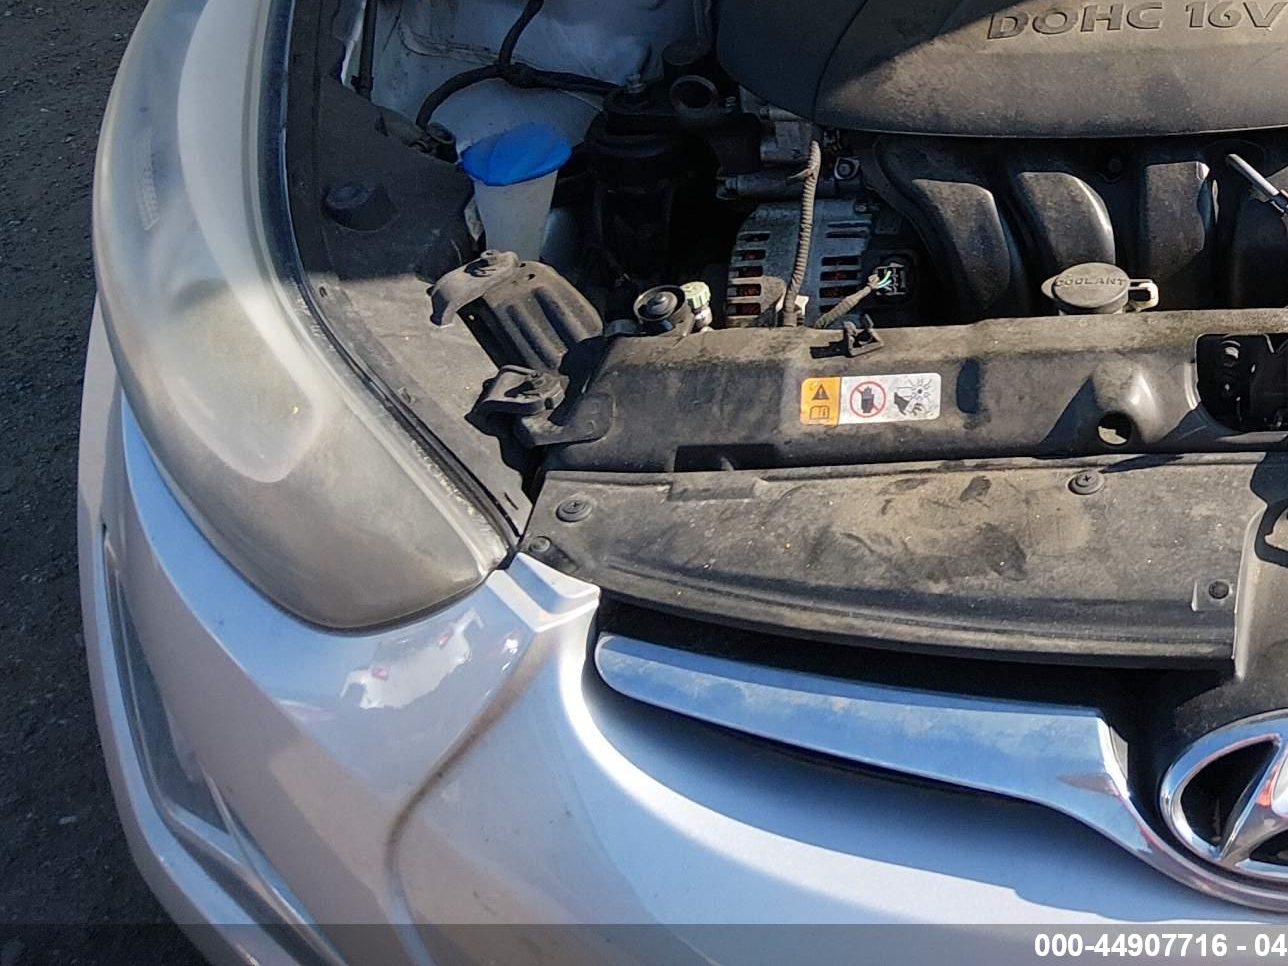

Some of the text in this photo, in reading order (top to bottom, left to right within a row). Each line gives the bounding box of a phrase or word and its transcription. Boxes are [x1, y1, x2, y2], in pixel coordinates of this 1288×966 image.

[986, 0, 1288, 40] DOHC 16V
[1054, 274, 1127, 287] COOLANT
